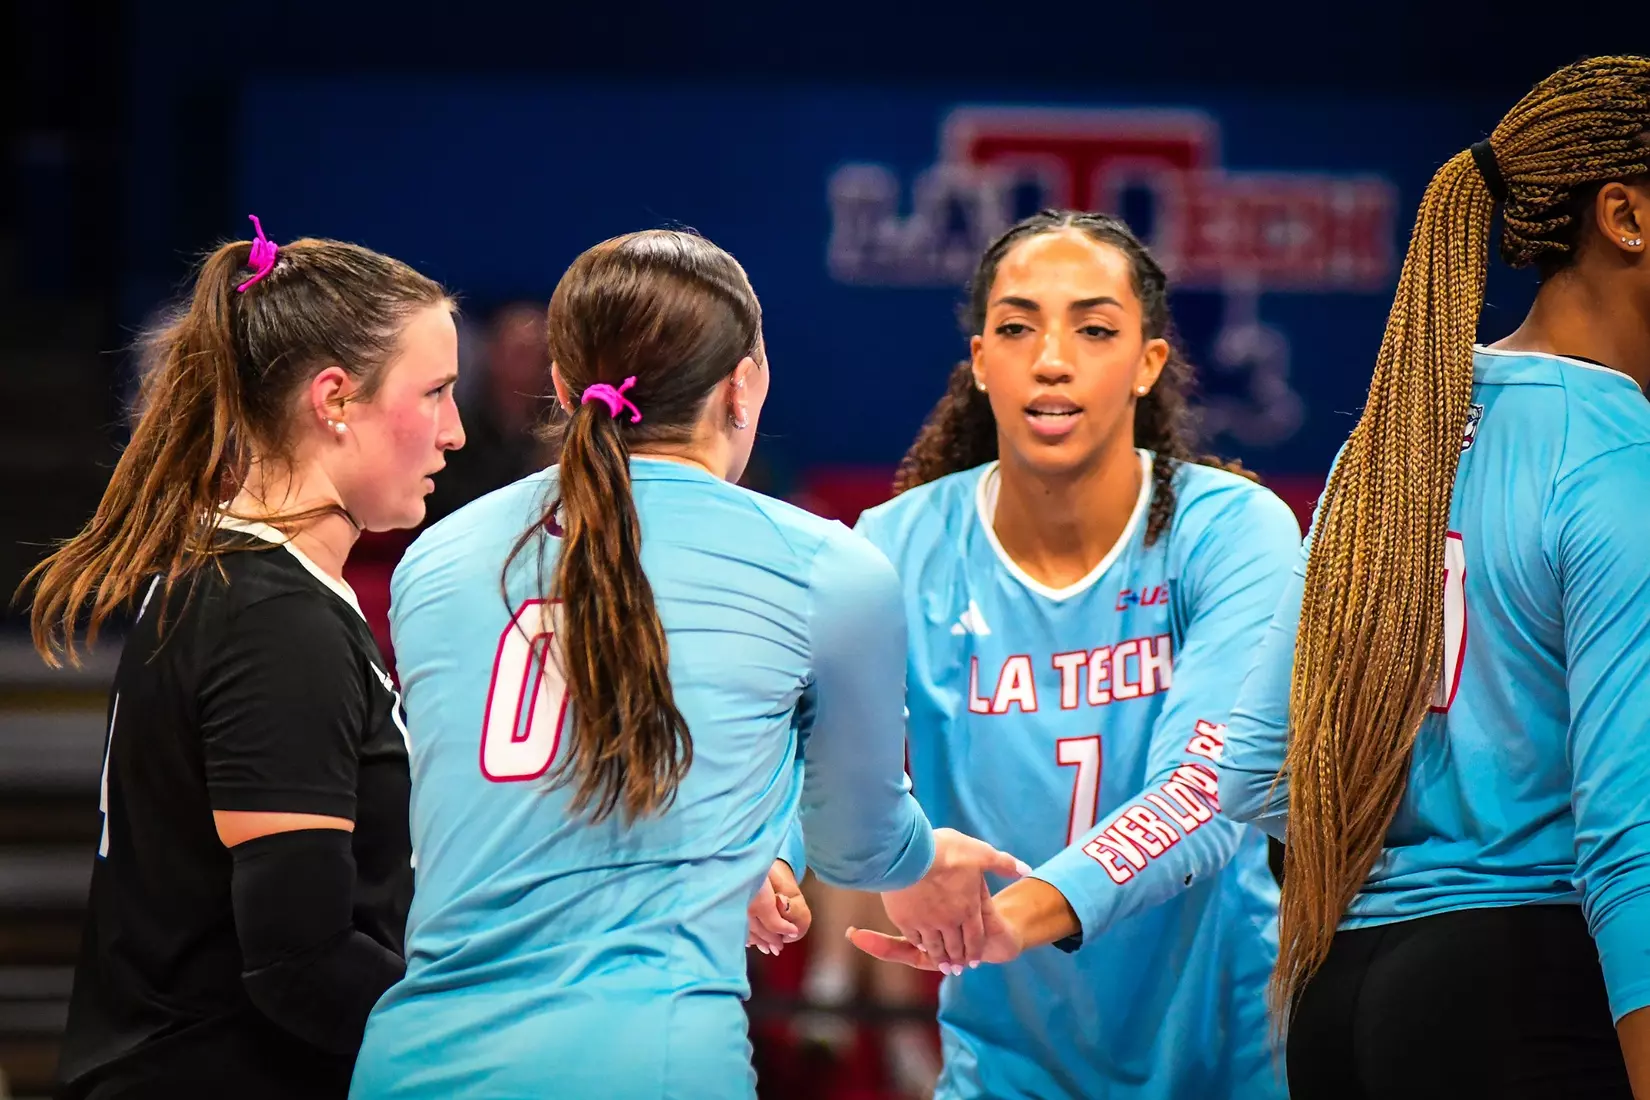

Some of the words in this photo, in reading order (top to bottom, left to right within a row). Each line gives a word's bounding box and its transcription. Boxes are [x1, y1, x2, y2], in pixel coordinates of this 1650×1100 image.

[968, 655, 1038, 714] LA
[1052, 633, 1173, 710] TECH
[1056, 735, 1102, 848] 7
[1082, 804, 1181, 886] EVER
